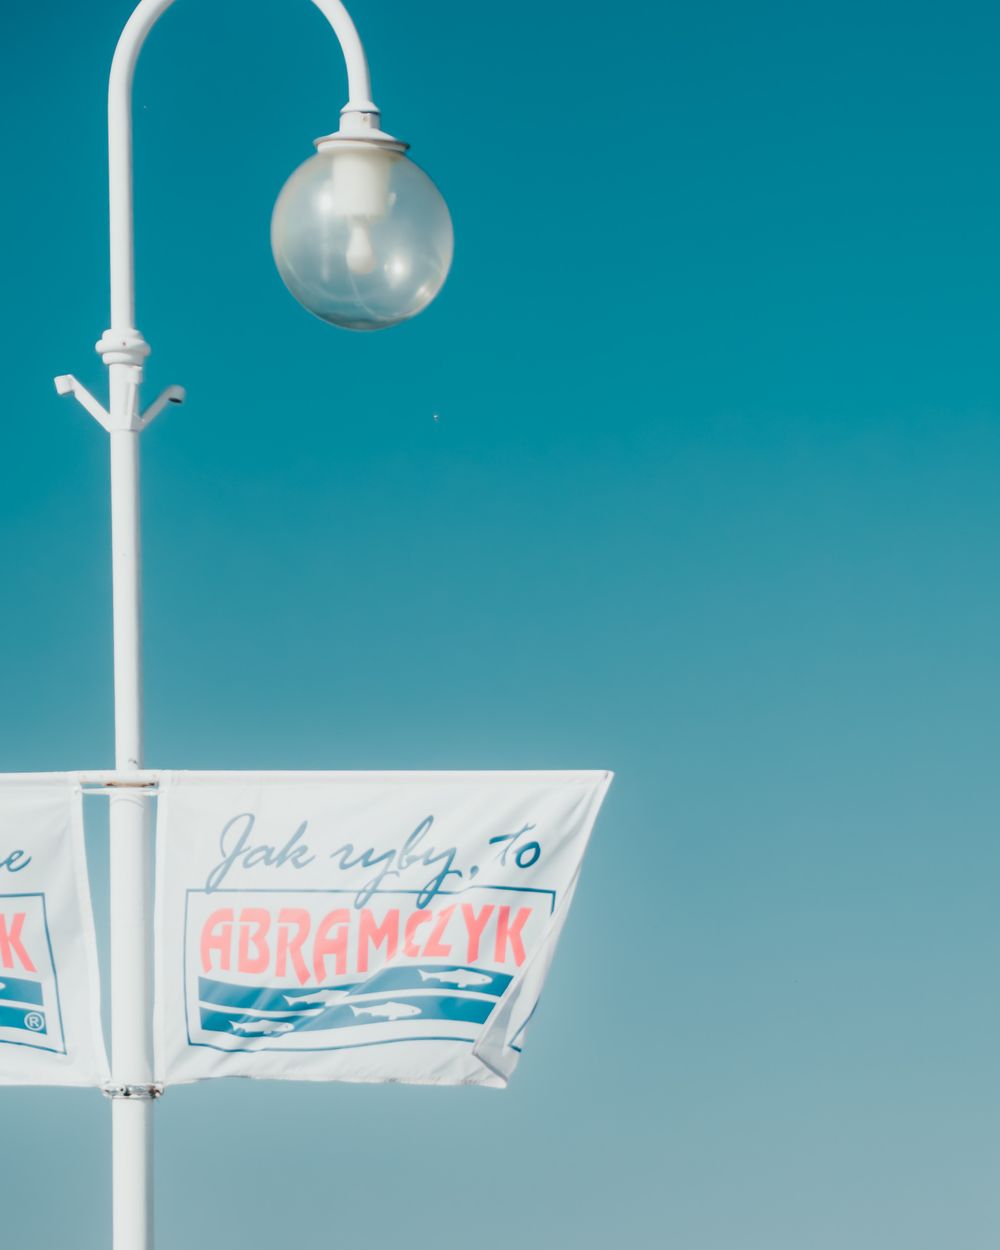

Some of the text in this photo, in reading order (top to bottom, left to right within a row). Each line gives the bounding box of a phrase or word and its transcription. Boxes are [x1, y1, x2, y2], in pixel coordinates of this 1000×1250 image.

[205, 812, 542, 910] Jak ryby, to
[200, 902, 534, 987] ABRAMCZYK
